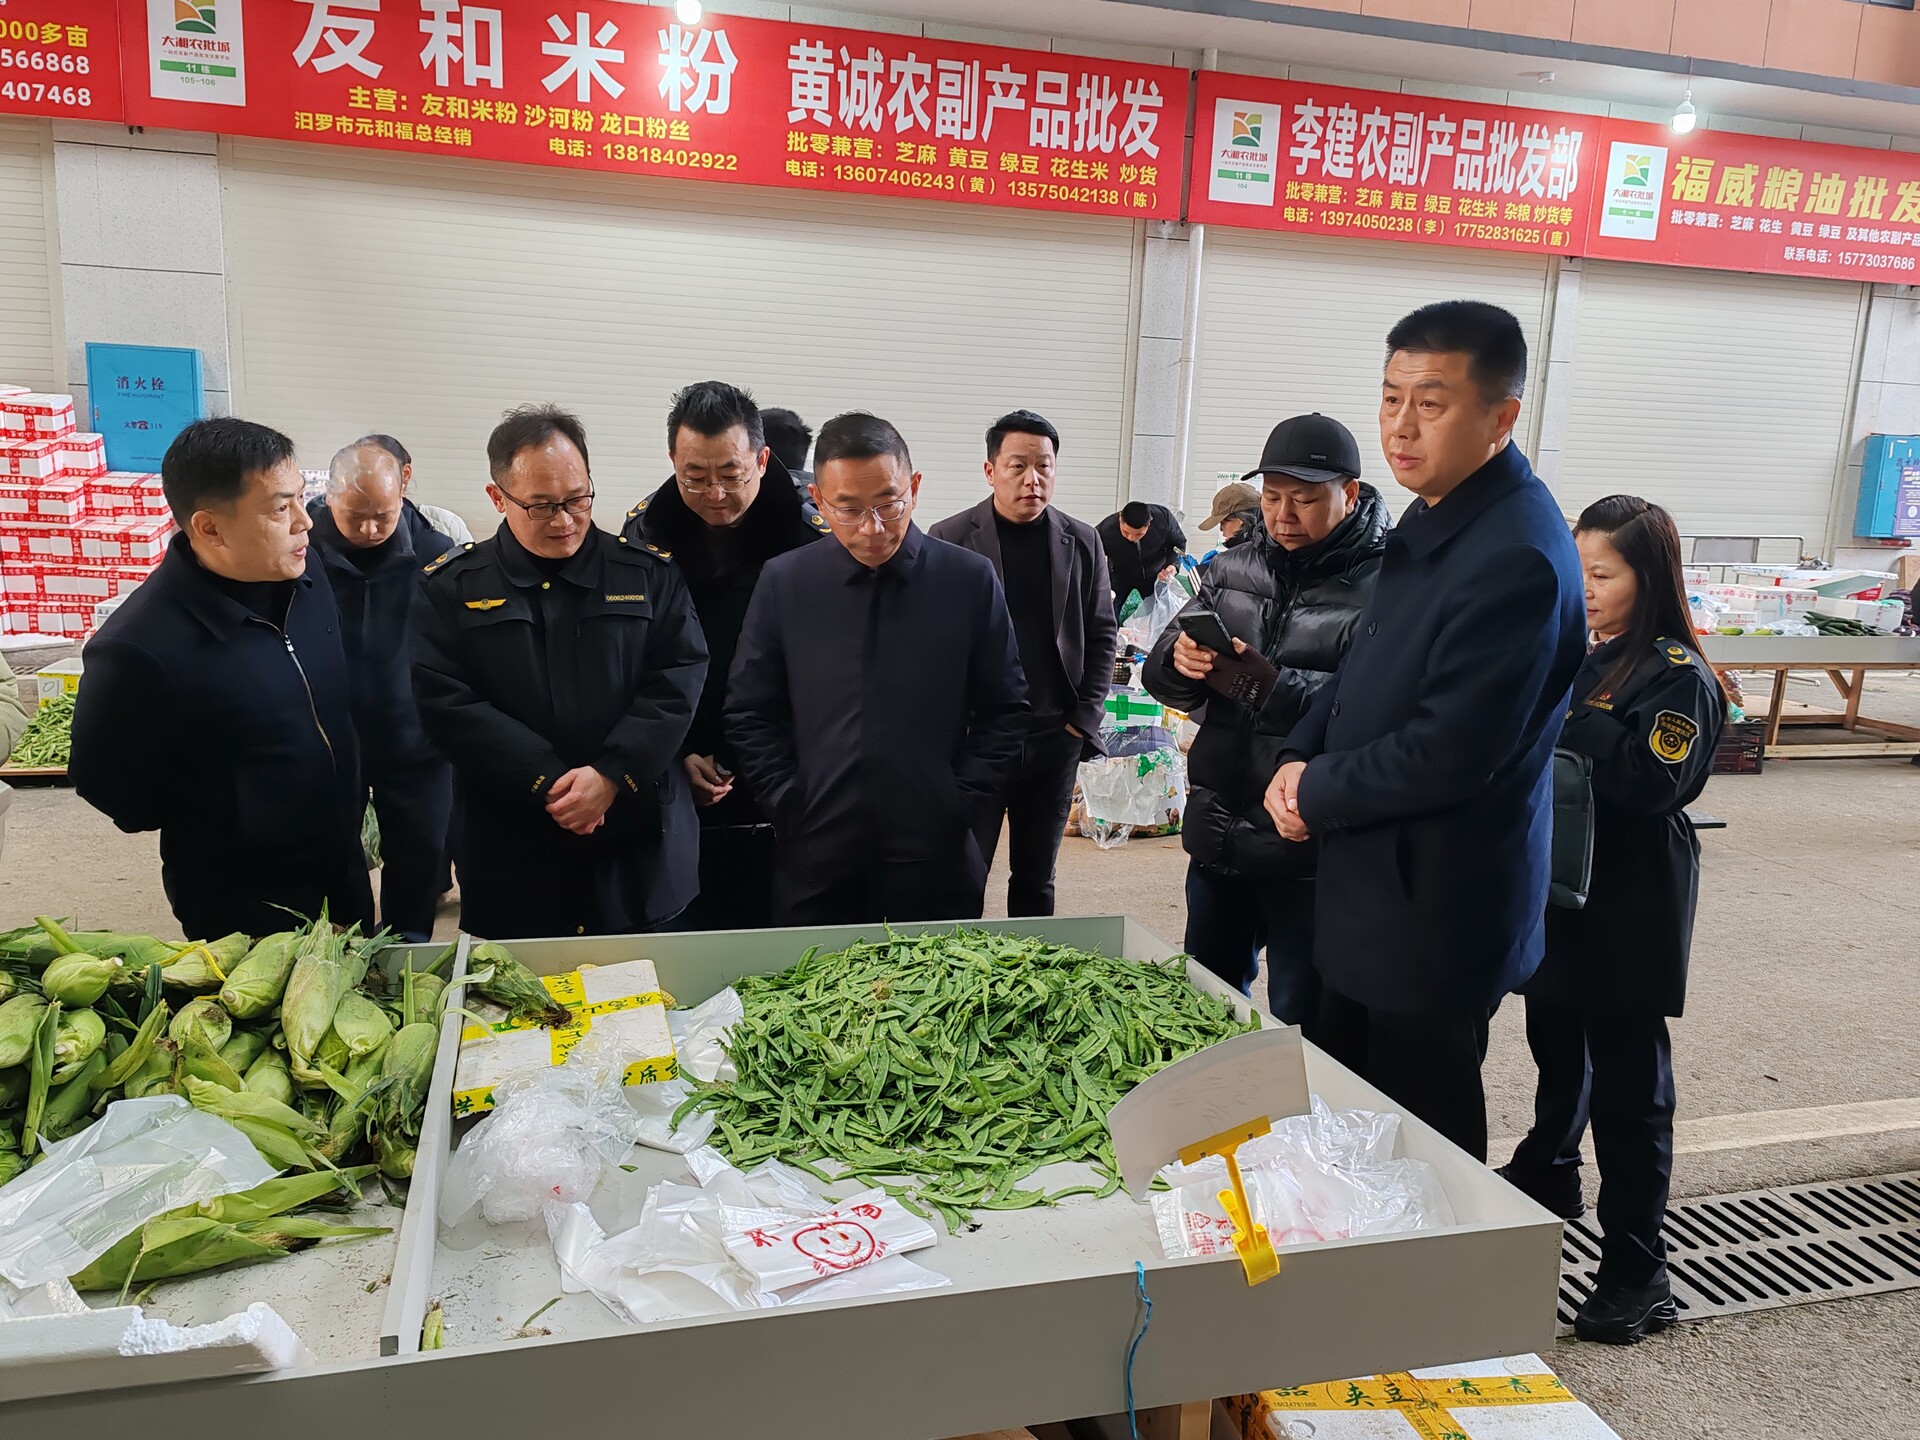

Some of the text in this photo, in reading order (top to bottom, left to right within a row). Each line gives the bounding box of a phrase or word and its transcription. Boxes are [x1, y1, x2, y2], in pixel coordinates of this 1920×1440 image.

[1, 48, 90, 75] 566868
[161, 35, 231, 53] 大湘农批城
[292, 0, 738, 114] 友和米粉
[1, 81, 92, 107] 407468
[787, 38, 1164, 160] 黄诚农副产品批发
[525, 105, 594, 132] 沙河粉
[600, 112, 691, 142] 龙口粉丝
[949, 147, 989, 171] 黄豆
[1000, 152, 1040, 176] 绿豆
[1051, 157, 1110, 182] 花生米
[1119, 163, 1158, 187] 炒货
[1289, 98, 1584, 202] 李建农副产品批发部
[1390, 191, 1417, 212] 黄豆
[1424, 194, 1451, 215] 绿豆
[1458, 197, 1498, 219] 花生米
[1504, 201, 1531, 222] 杂粮
[1533, 204, 1573, 226] 炒货等
[1670, 156, 1920, 225] 福威粮油批发
[1759, 218, 1783, 234] 花生
[1790, 221, 1813, 237] 黄豆
[1818, 223, 1841, 239] 绿豆
[1846, 226, 1920, 248] 及其他农副产品
[116, 376, 165, 391] 消火栓
